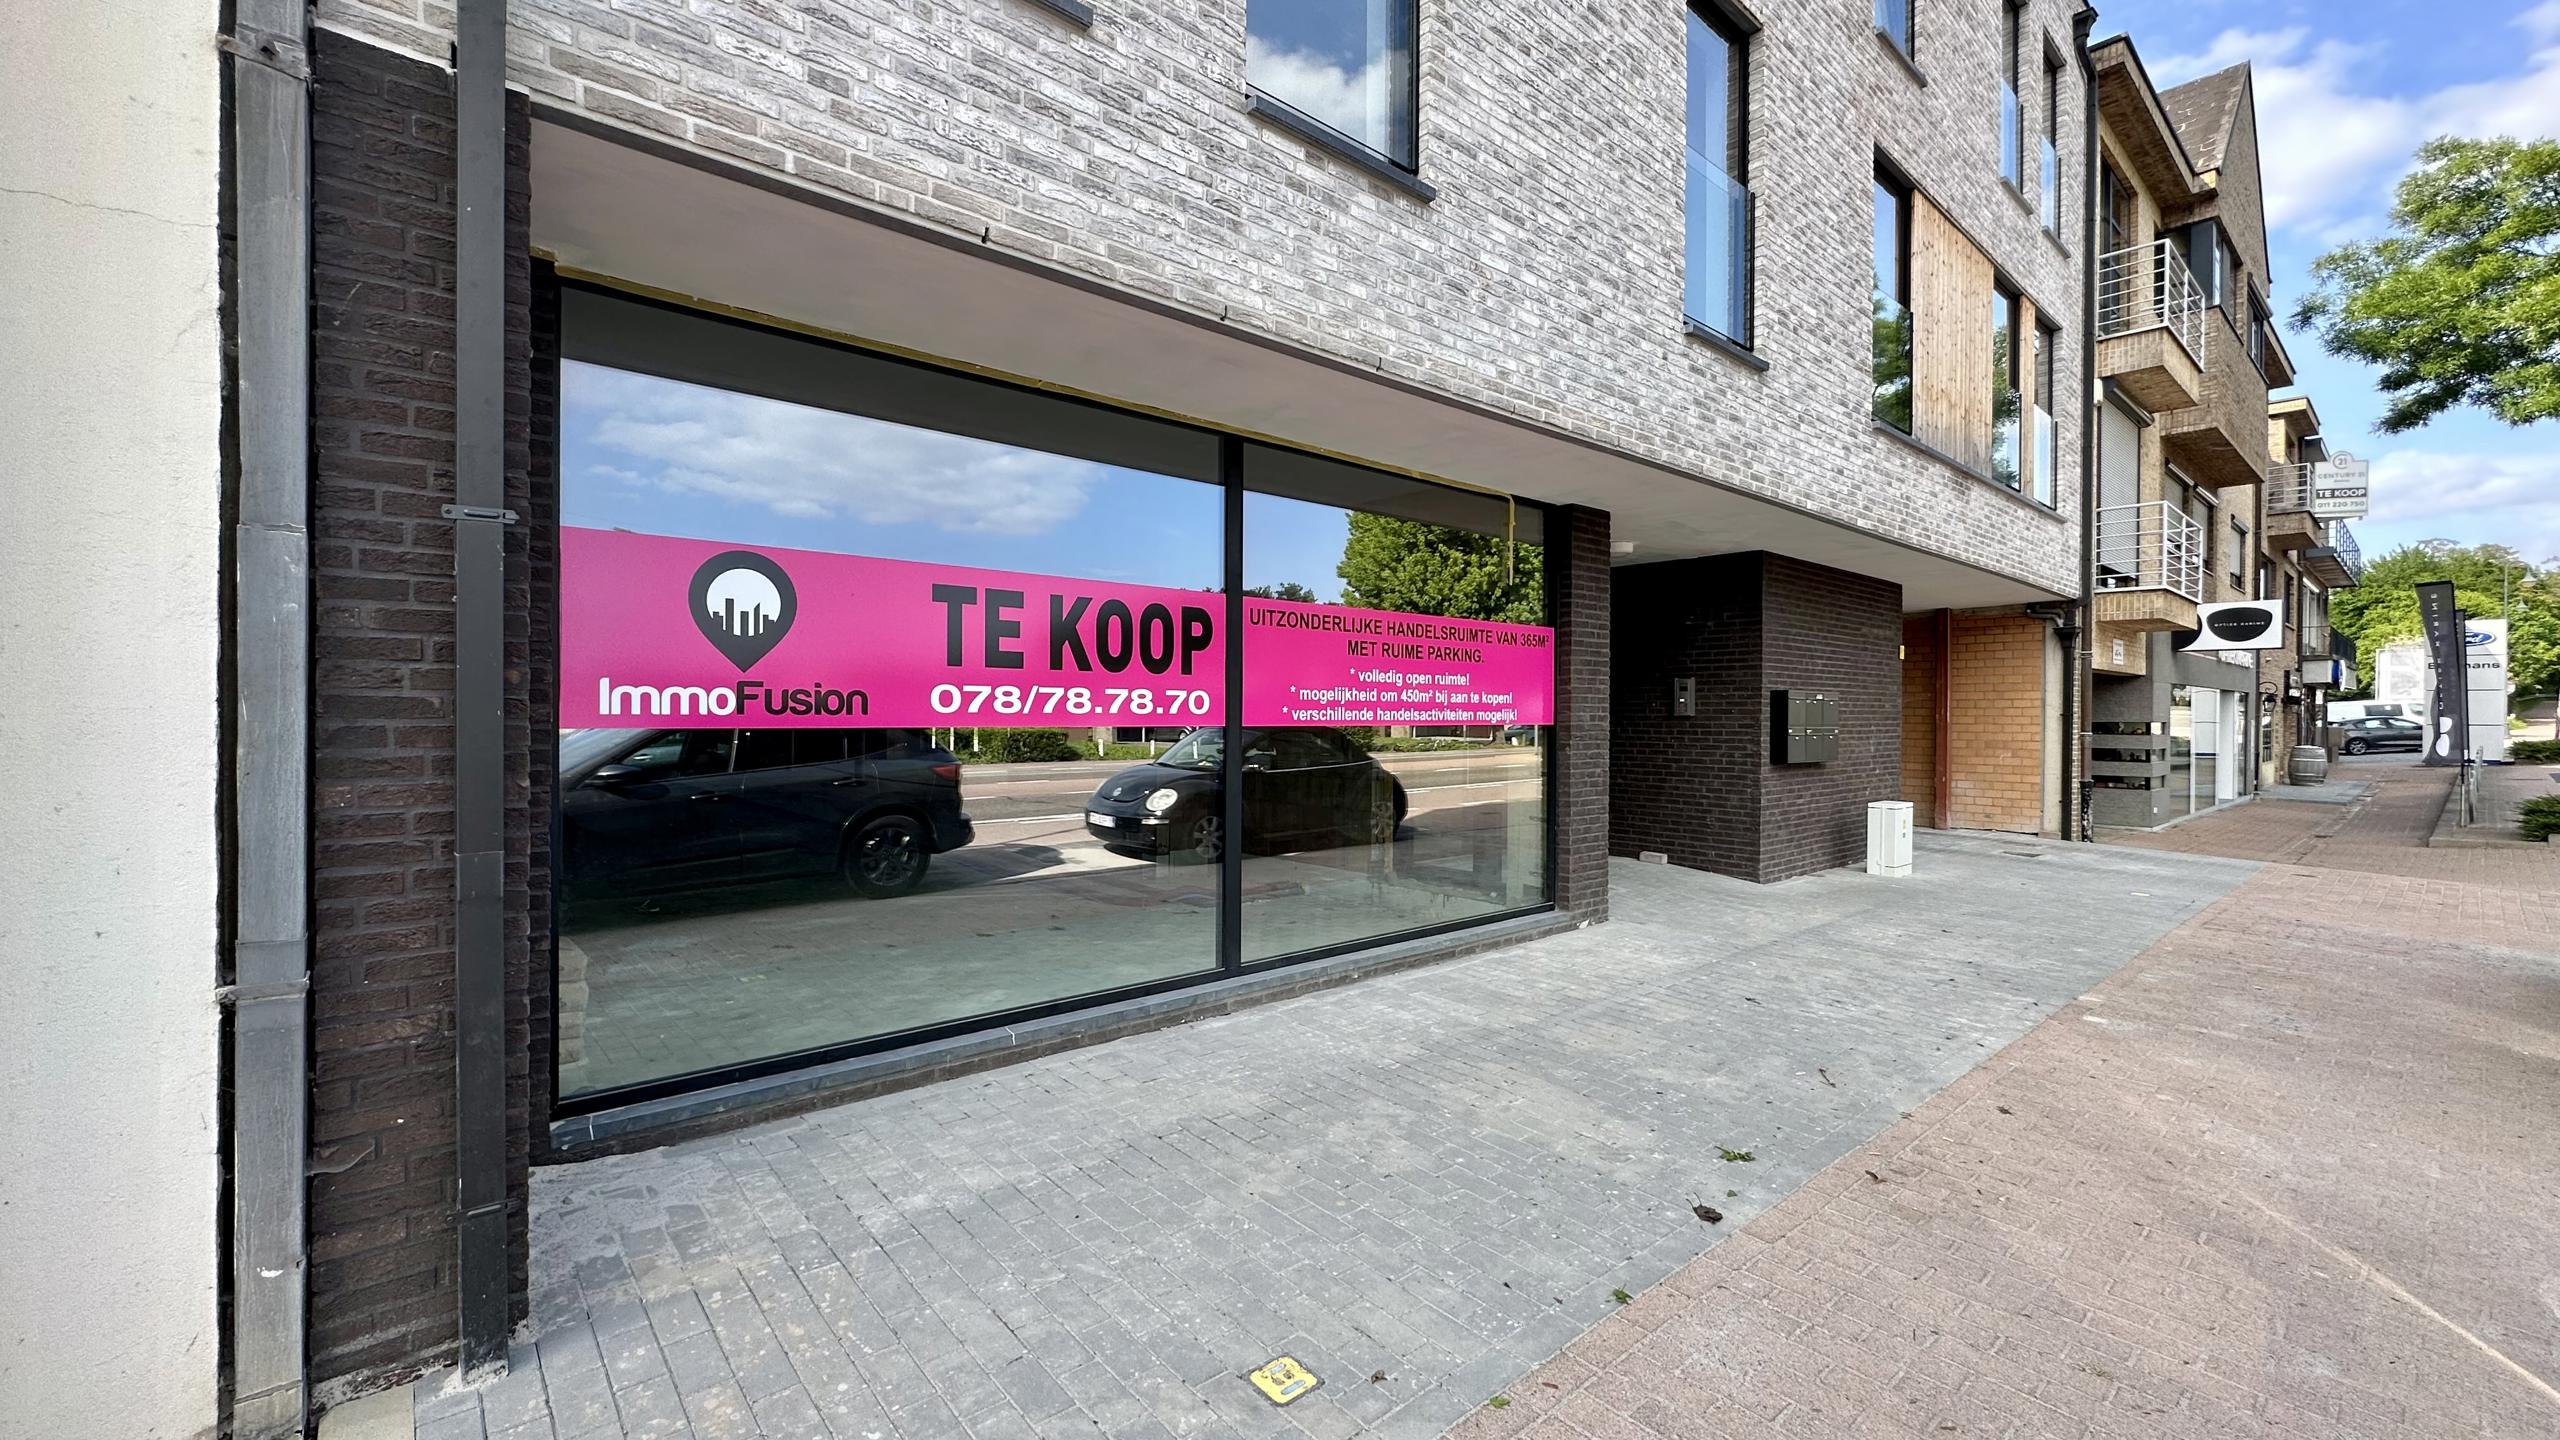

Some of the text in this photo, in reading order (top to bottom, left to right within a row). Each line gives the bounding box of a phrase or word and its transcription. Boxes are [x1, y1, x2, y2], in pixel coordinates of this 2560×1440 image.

[2317, 472, 2356, 480] CENTURY
[2317, 489, 2366, 498] TE KOOP
[931, 584, 1214, 676] TE KOOP
[1249, 607, 1383, 635] UITZONDERLIJKE
[1386, 620, 1493, 644] HANDELSRUIMTE
[1495, 630, 1518, 646] VAN
[1347, 639, 1485, 663] MET RUIME PARKING.
[1357, 668, 1470, 687] volledig open ruimte!
[599, 677, 869, 716] ImmoFusion
[930, 683, 1210, 715] 078/78.78.70
[1299, 686, 1378, 705] mogelijkheid
[1379, 691, 1398, 702] om
[1435, 689, 1448, 706] bij
[1449, 692, 1469, 704] aan
[1469, 691, 1480, 704] te
[1481, 690, 1513, 707] kopen!
[1291, 706, 1518, 725] verschillende handelsactiviteiten mogelijk!
